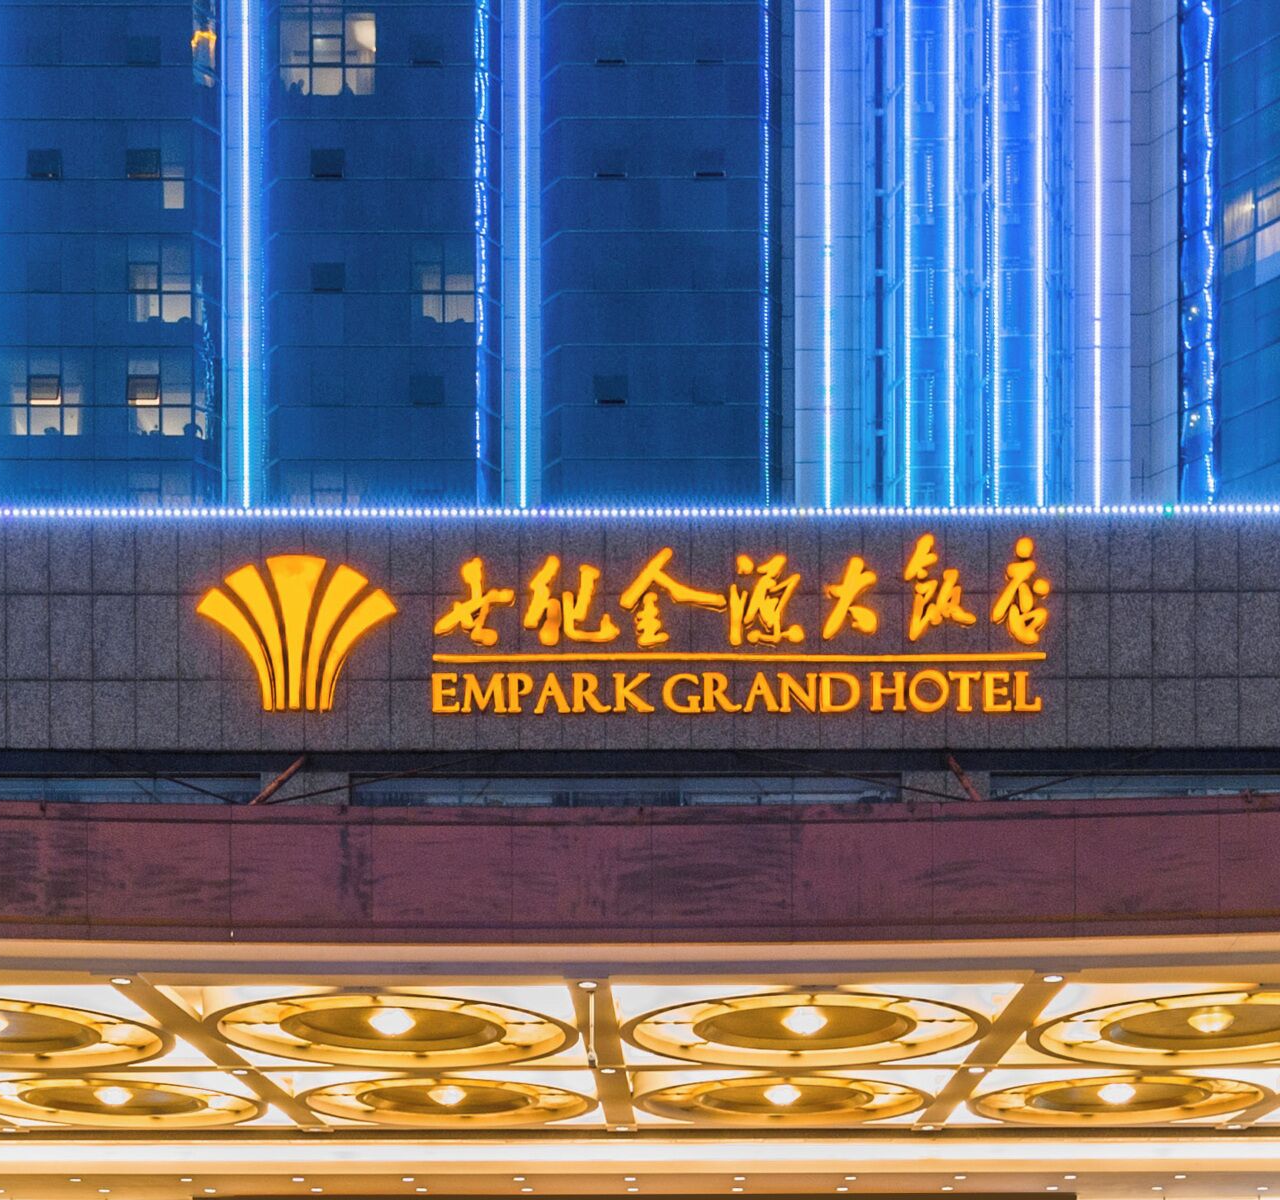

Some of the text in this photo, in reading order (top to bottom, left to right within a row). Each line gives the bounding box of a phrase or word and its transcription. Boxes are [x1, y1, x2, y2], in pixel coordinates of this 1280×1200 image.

[430, 669, 1042, 714] EMPARK GRAND HOTEL
